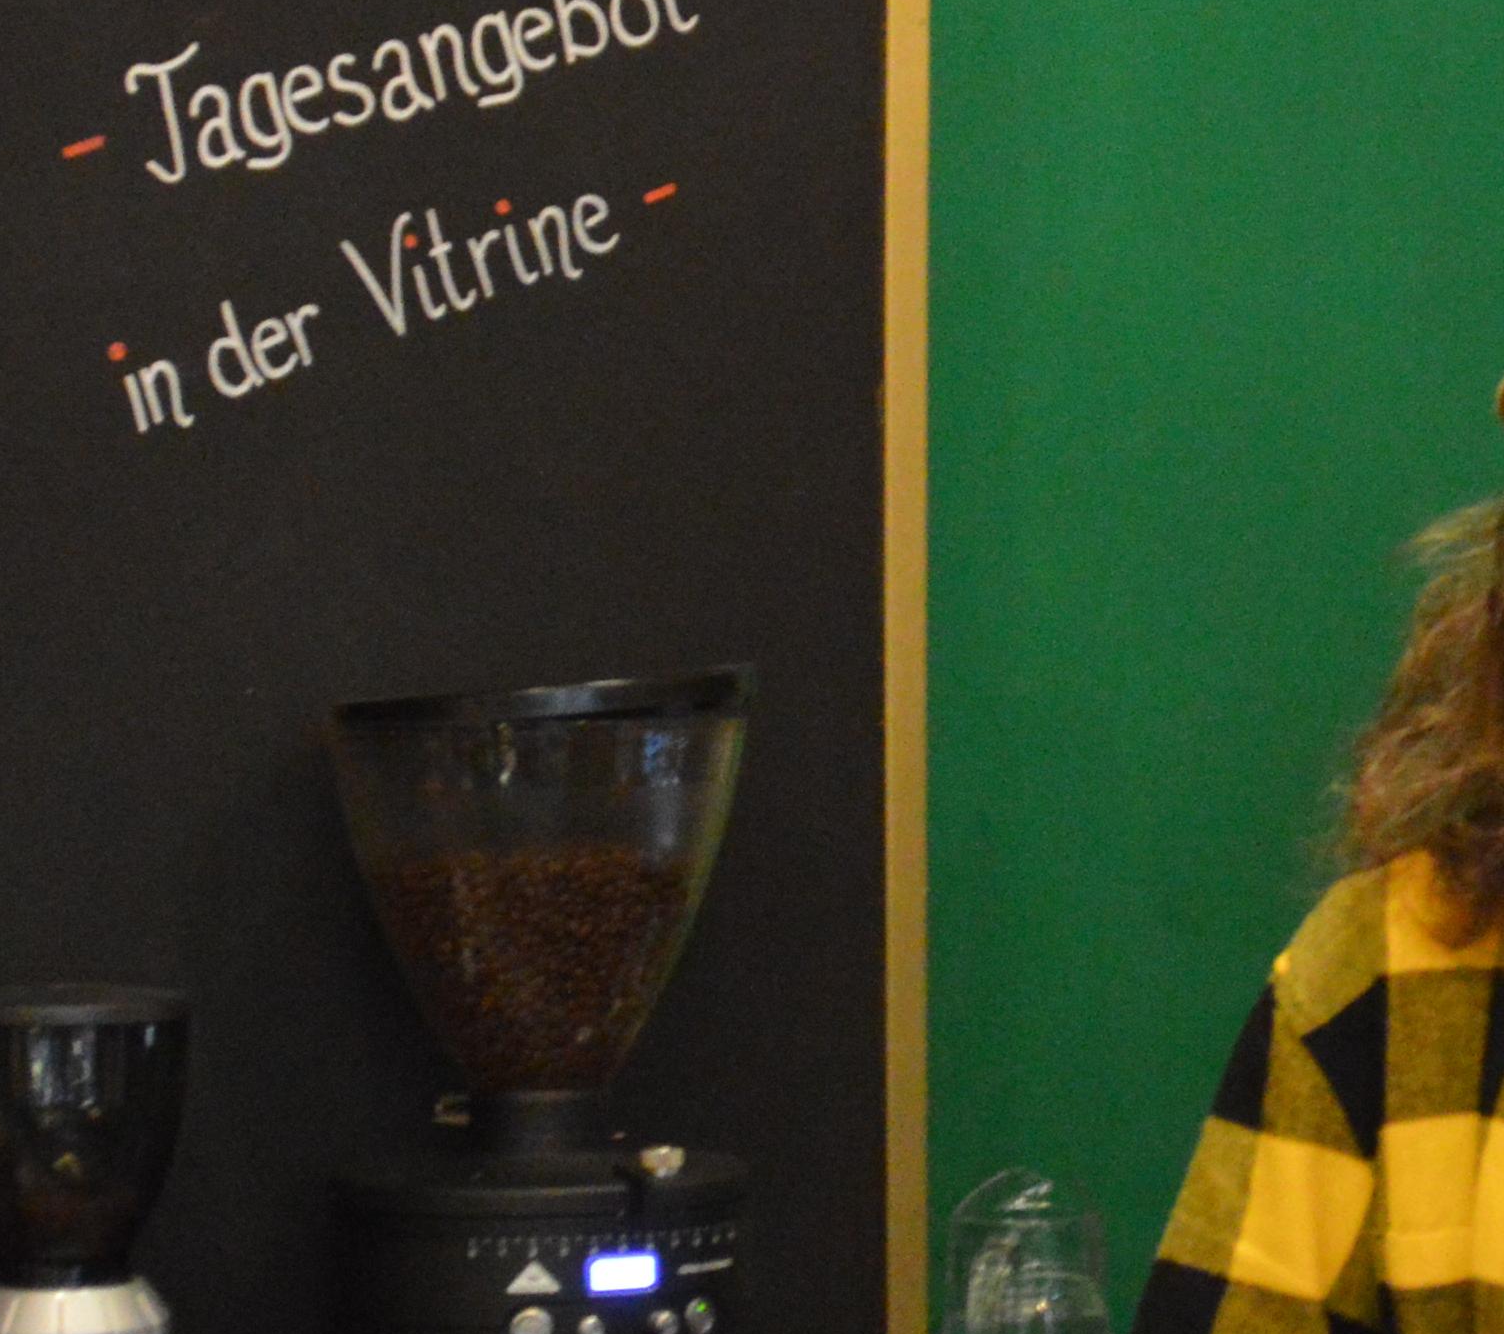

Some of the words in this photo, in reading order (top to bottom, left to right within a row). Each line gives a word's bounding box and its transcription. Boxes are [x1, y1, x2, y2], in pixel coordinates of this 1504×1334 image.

[106, 341, 196, 434] in
[207, 299, 320, 399] der
[340, 193, 620, 336] Vitrine
